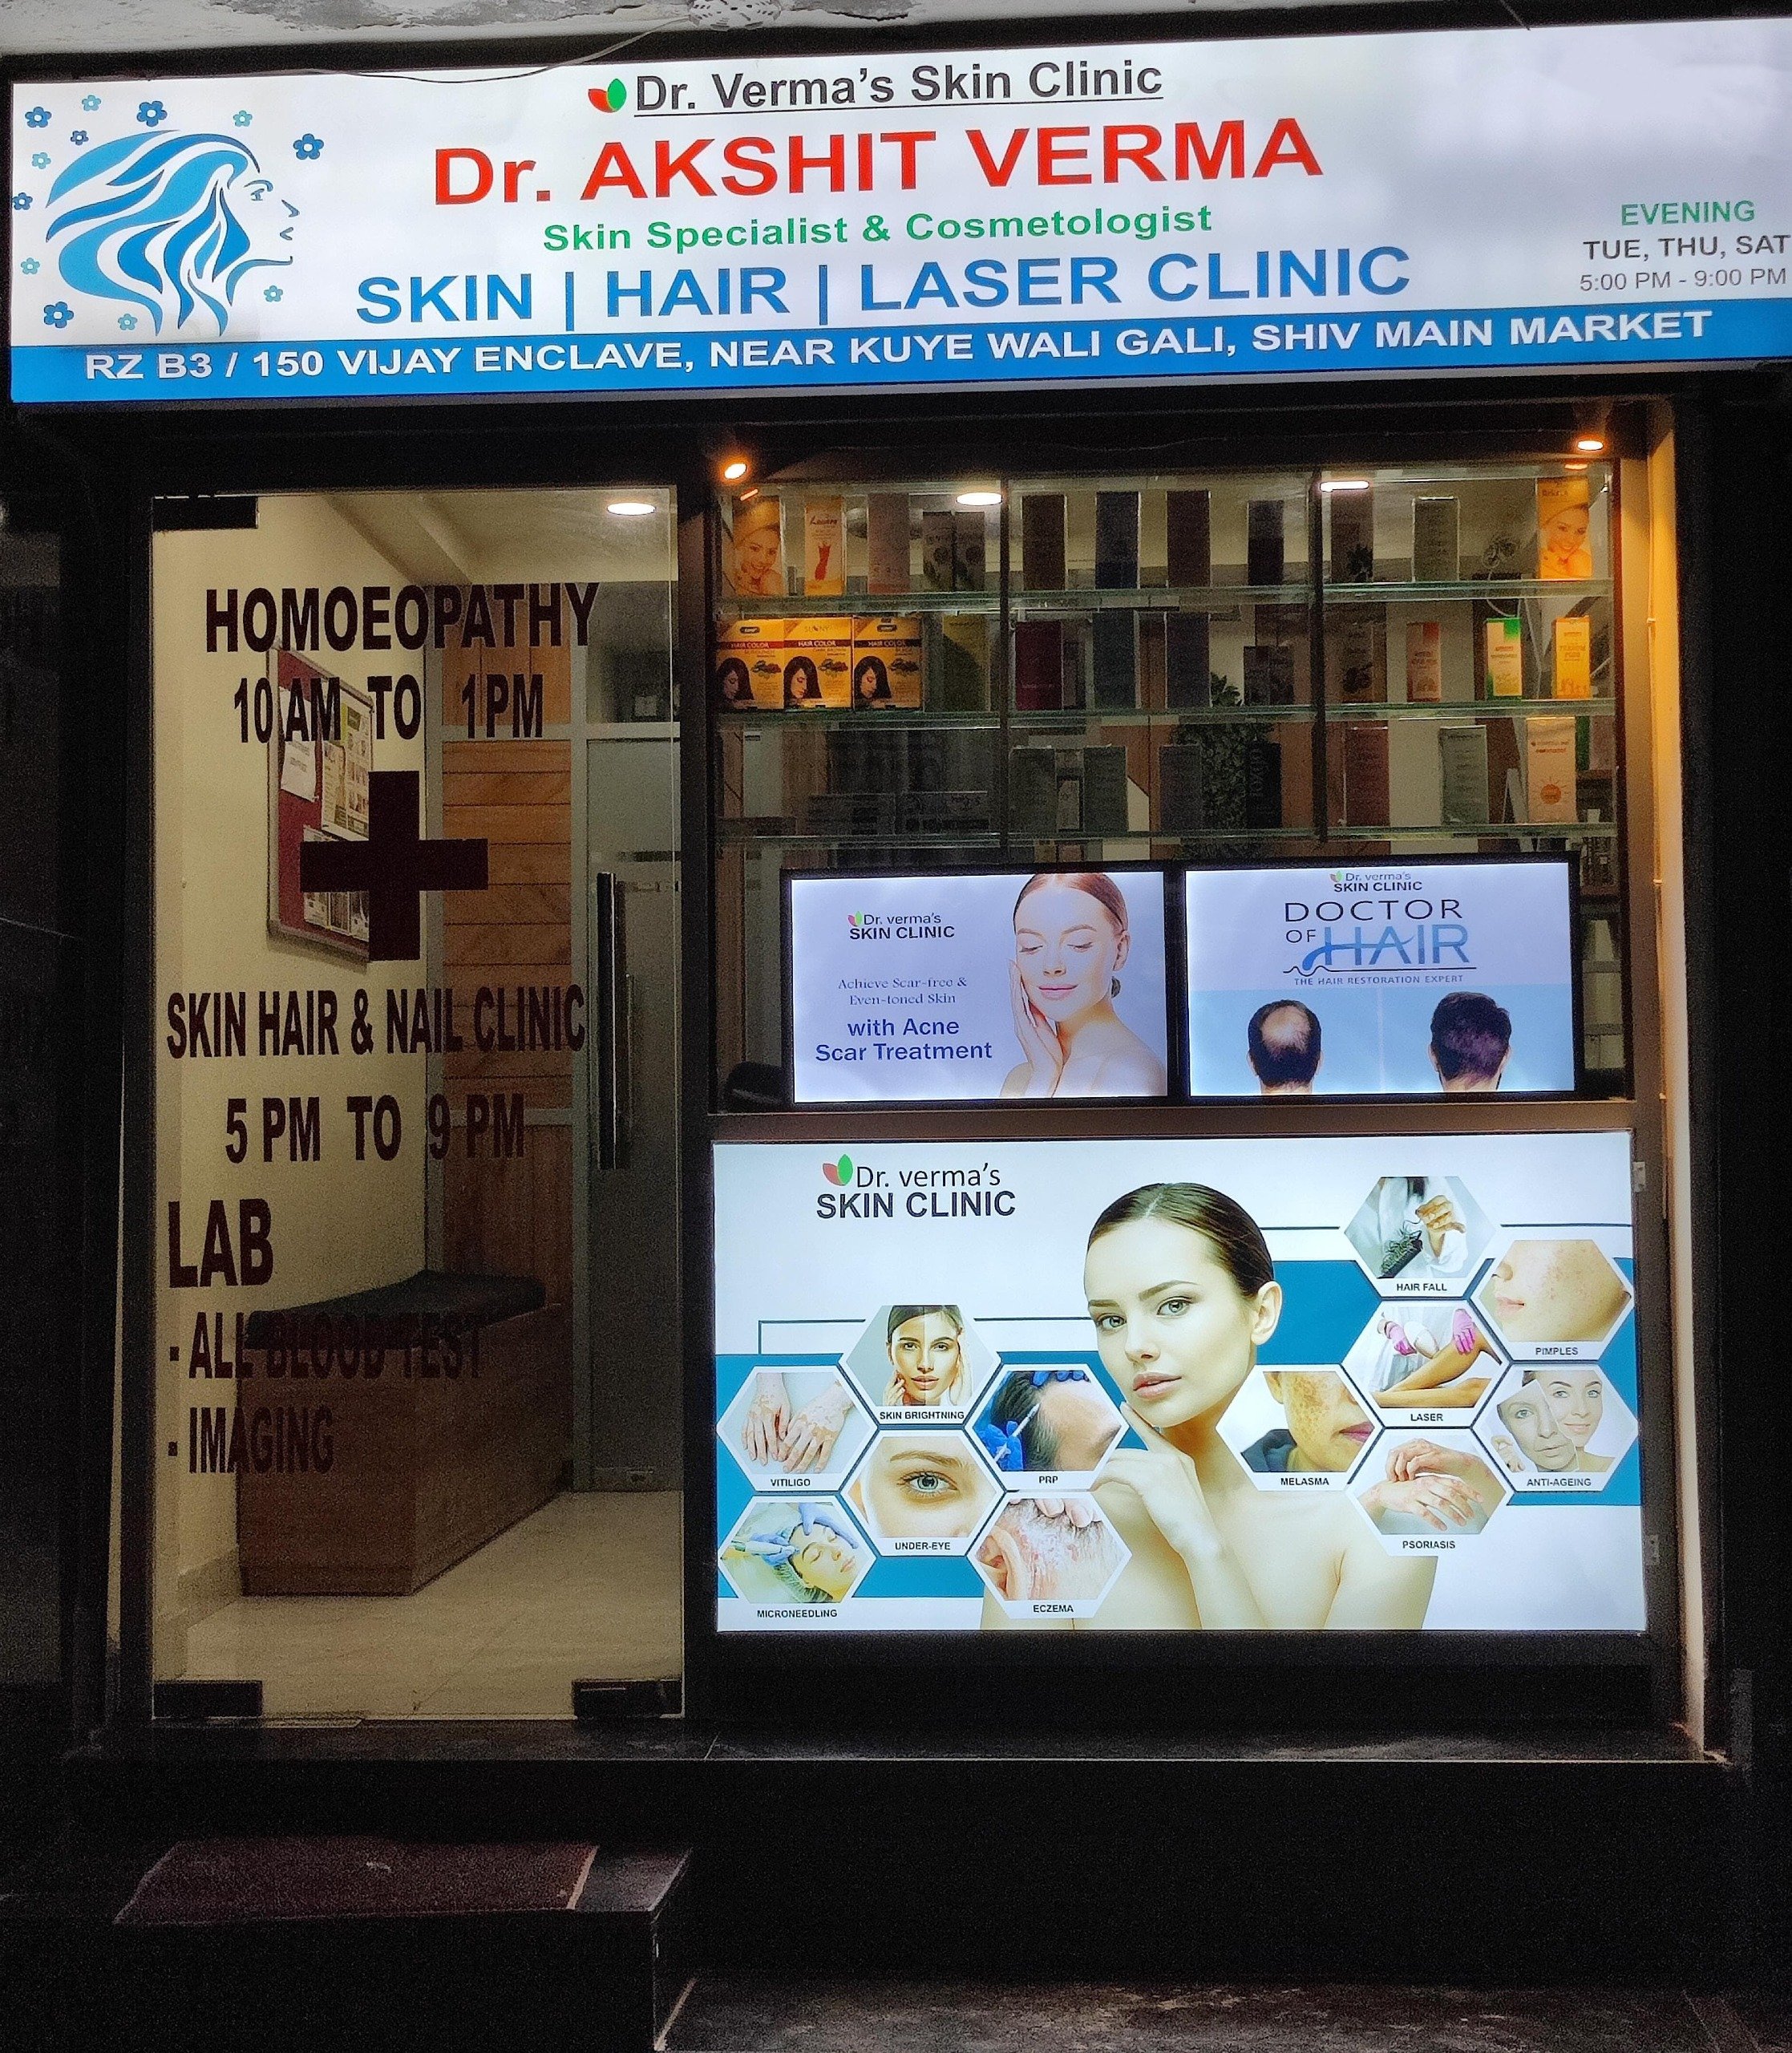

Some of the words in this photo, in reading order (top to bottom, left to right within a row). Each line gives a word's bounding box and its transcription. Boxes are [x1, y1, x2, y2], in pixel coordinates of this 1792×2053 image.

[637, 75, 696, 111] Dr.
[713, 69, 895, 108] Verma's
[911, 63, 1009, 101] Skin
[1029, 60, 1162, 97] Clinic
[435, 148, 550, 204] Dr.
[580, 132, 936, 200] AKSHIT
[966, 118, 1324, 185] VERMA
[1621, 200, 1756, 225] EVENING
[544, 225, 630, 252] Skin
[648, 217, 847, 253] Specialist
[863, 213, 889, 241] &
[907, 205, 1212, 242] Cosmetologist
[1583, 240, 1649, 261] TUE,
[1658, 237, 1725, 259] THU,
[1736, 234, 1791, 255] SAT
[357, 273, 531, 323] SKIN
[608, 267, 791, 317] HAIR
[861, 257, 1121, 311] LASER
[1148, 245, 1410, 302] CLINIC
[1580, 272, 1627, 292] 5:00
[1636, 271, 1671, 290] PM
[1694, 268, 1741, 287] 9:00
[1751, 266, 1786, 285] PM
[87, 354, 144, 379] RZ
[158, 352, 212, 379] B3
[225, 351, 237, 379] /
[253, 351, 322, 377] 150
[337, 348, 461, 376] VIJAY
[475, 342, 694, 372] ENCLAVE,
[710, 341, 835, 368] NEAR
[851, 335, 973, 364] KUYE
[987, 330, 1100, 359] WALI
[1116, 325, 1236, 358] GALI,
[1252, 323, 1361, 351] SHIV
[1376, 319, 1492, 347] MAIN
[1511, 311, 1712, 344] MARKET
[206, 583, 599, 652] HOMOEOPATHY
[234, 677, 273, 743] 10
[285, 677, 341, 742] AM
[367, 674, 421, 740] TO
[1345, 873, 1361, 881] Dr.
[1365, 871, 1411, 881] verma's
[1334, 883, 1369, 892] SKIN
[1373, 881, 1422, 891] CLINIC
[864, 914, 882, 924] Dr.
[887, 913, 941, 925] verma's
[1285, 899, 1462, 921] DOCTOR
[850, 927, 891, 940] SKIN
[896, 925, 955, 938] CLINIC
[1286, 929, 1316, 943] OF
[1302, 924, 1469, 970] HAIR
[838, 978, 888, 989] Achieve
[892, 978, 953, 988] Scar-free
[958, 977, 967, 986] &
[1348, 976, 1420, 984] RESTORATION
[1425, 974, 1462, 983] EXPERT
[850, 994, 924, 1005] Even-toned
[928, 993, 956, 1003] Skin
[167, 991, 245, 1059] SKIN
[259, 990, 338, 1057] HAIR
[351, 989, 374, 1054] &
[387, 988, 462, 1054] NAIL
[475, 984, 585, 1051] CLINIC
[848, 1018, 895, 1036] with
[904, 1018, 960, 1035] Acne
[815, 1044, 866, 1061] Scar
[873, 1042, 993, 1059] Treatment
[226, 1099, 247, 1163] 5
[263, 1096, 320, 1162] PM
[347, 1095, 401, 1160] TO
[428, 1094, 450, 1160] 9
[467, 1094, 524, 1158] PM
[856, 1166, 889, 1188] Dr.
[899, 1163, 1000, 1187] verma's
[817, 1193, 893, 1218] SKIN
[906, 1191, 1015, 1217] CLINIC
[168, 1198, 273, 1288] LAB
[1397, 1283, 1419, 1291] HAIR
[1423, 1283, 1447, 1291] FALL
[189, 1312, 253, 1379] ALL
[266, 1312, 385, 1379] BLOOD
[400, 1313, 483, 1379] TEST
[1535, 1346, 1578, 1355] PIMPLES
[880, 1411, 901, 1419] SKIN
[904, 1411, 965, 1419] BRIGHTNING
[1410, 1413, 1443, 1422] LASER
[189, 1407, 334, 1473] IMAGING
[771, 1479, 811, 1487] VITILIGO
[1039, 1476, 1058, 1484] PRP
[1280, 1477, 1329, 1486] MELASMA
[1527, 1478, 1592, 1487] ANTI-AGEING
[895, 1541, 950, 1550] UNDER-EYE
[1402, 1540, 1455, 1549] PSORIASIS
[757, 1610, 837, 1618] MICRONEEDLING
[1033, 1605, 1074, 1613] ECZEMA
